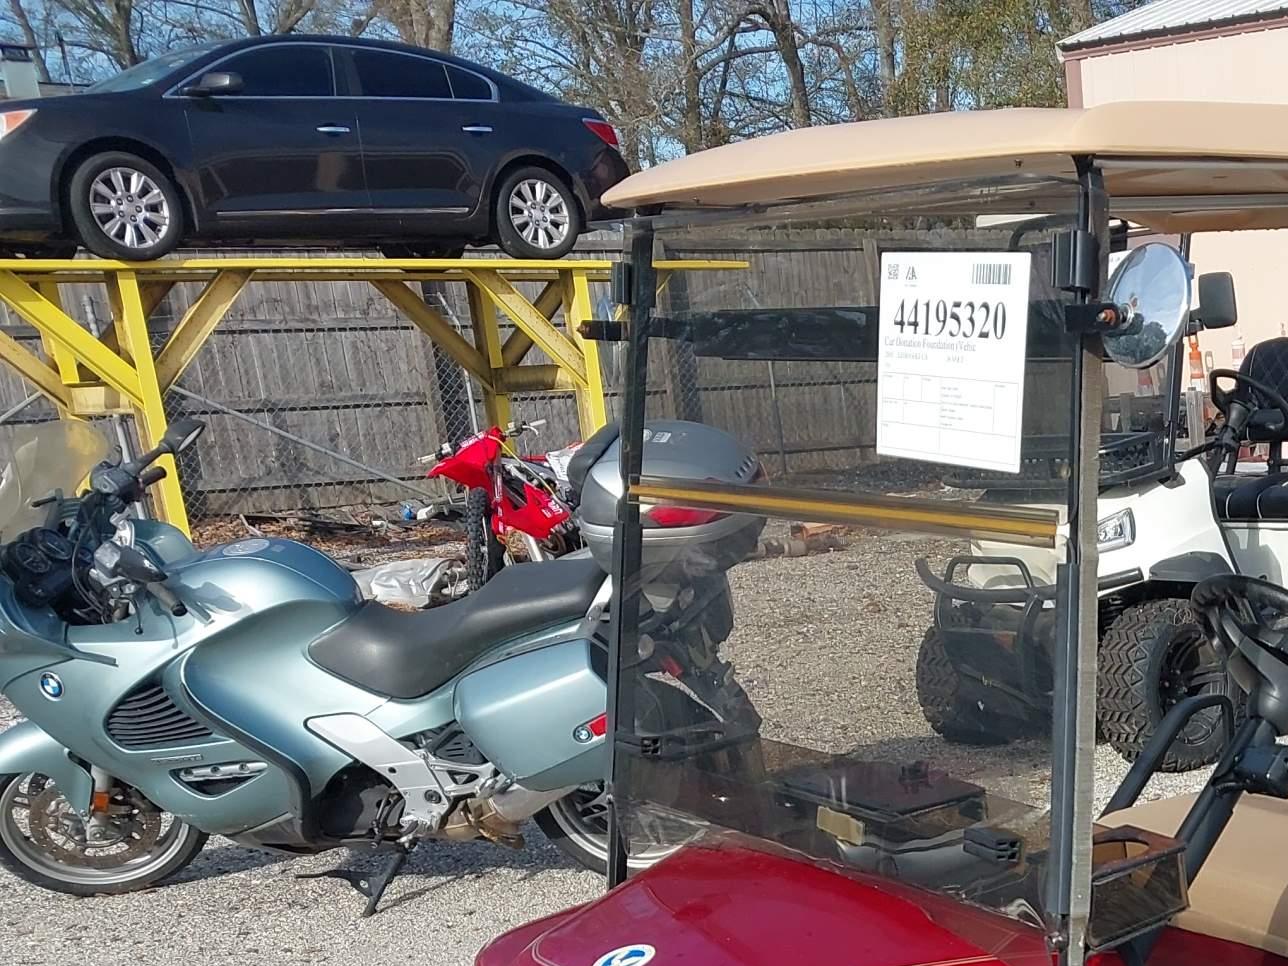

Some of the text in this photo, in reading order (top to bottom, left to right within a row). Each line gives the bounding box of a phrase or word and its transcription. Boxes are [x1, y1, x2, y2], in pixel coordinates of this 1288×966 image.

[893, 298, 1007, 340] 44195320
[896, 337, 921, 348] Donation
[922, 338, 954, 351] Foundation
